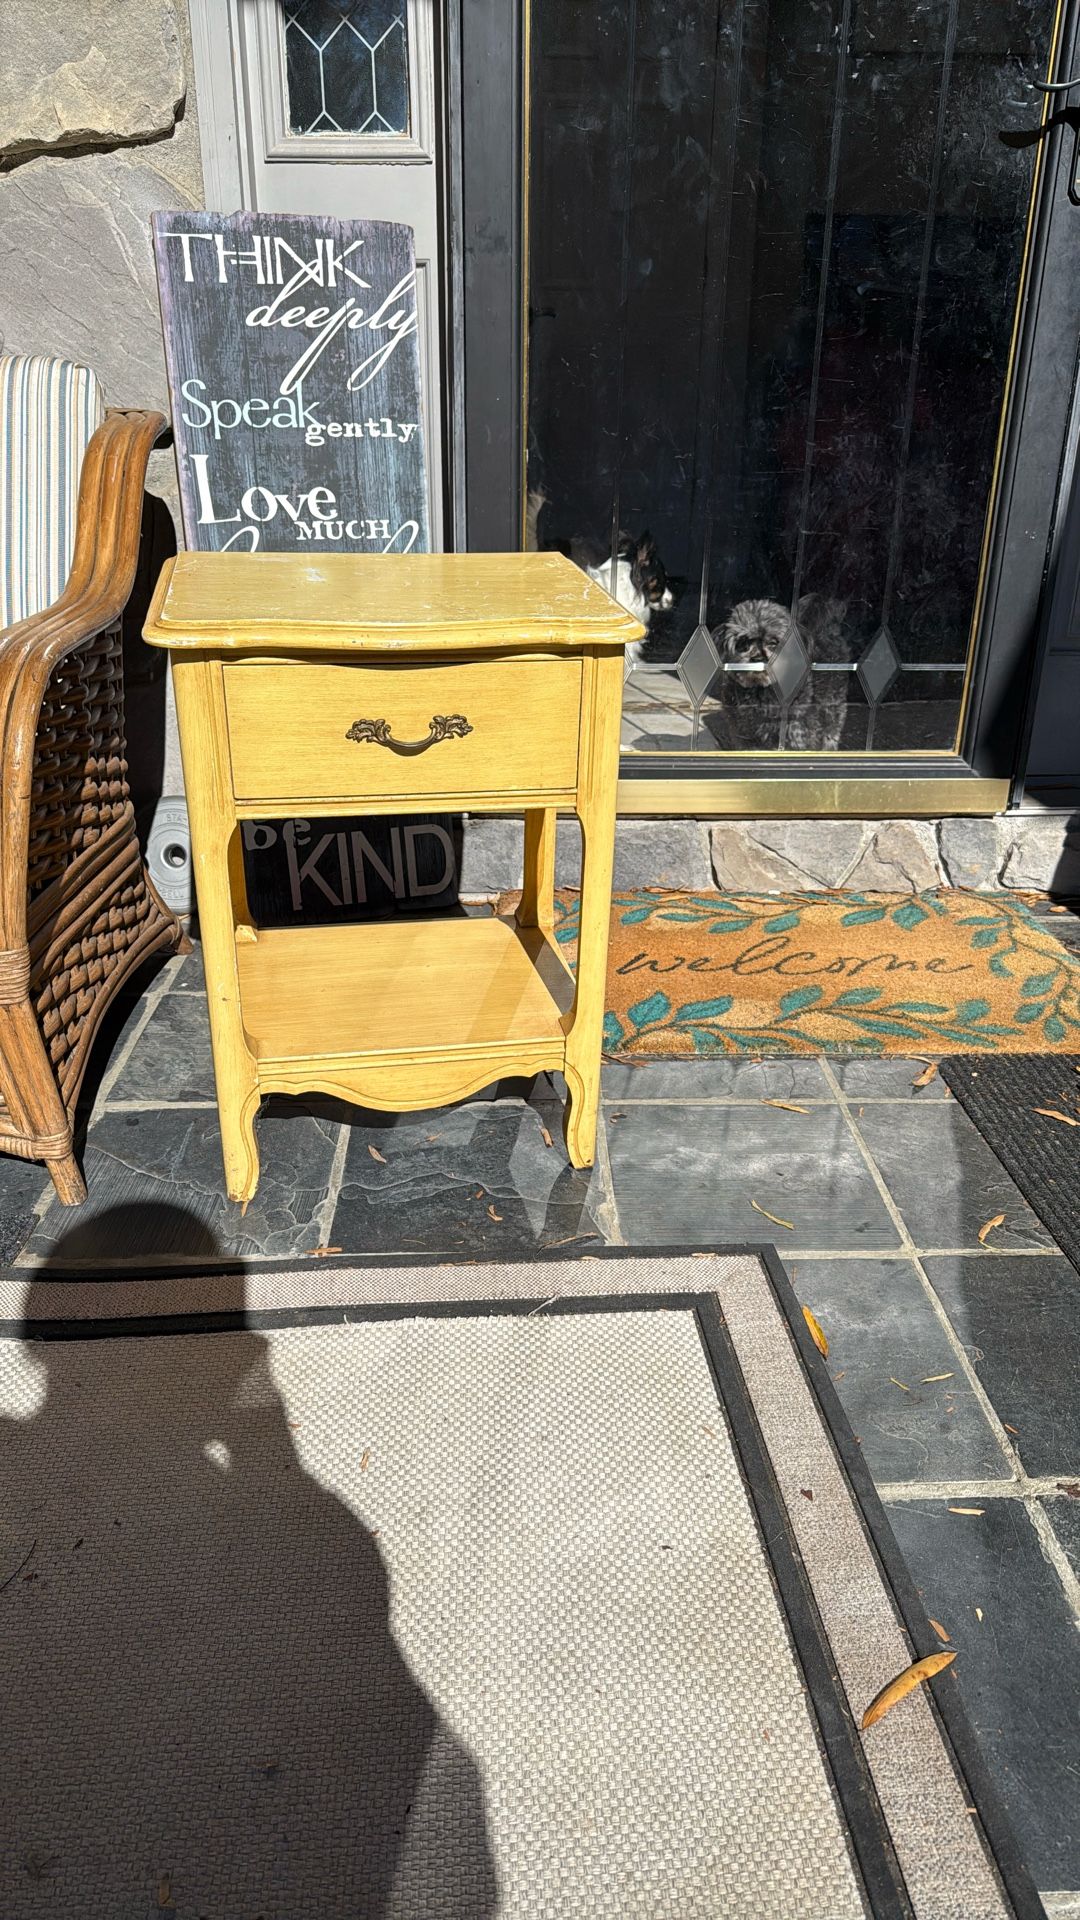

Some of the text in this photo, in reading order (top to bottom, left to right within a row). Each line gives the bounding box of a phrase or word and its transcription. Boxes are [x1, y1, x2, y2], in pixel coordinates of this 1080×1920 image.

[158, 233, 372, 288] THINK
[245, 258, 418, 395] deeply
[181, 379, 320, 439] Speak
[305, 418, 419, 446] gently
[189, 454, 338, 524] Love
[294, 519, 391, 540] MUCH
[282, 823, 456, 911] KIND
[616, 936, 974, 976] welcome
